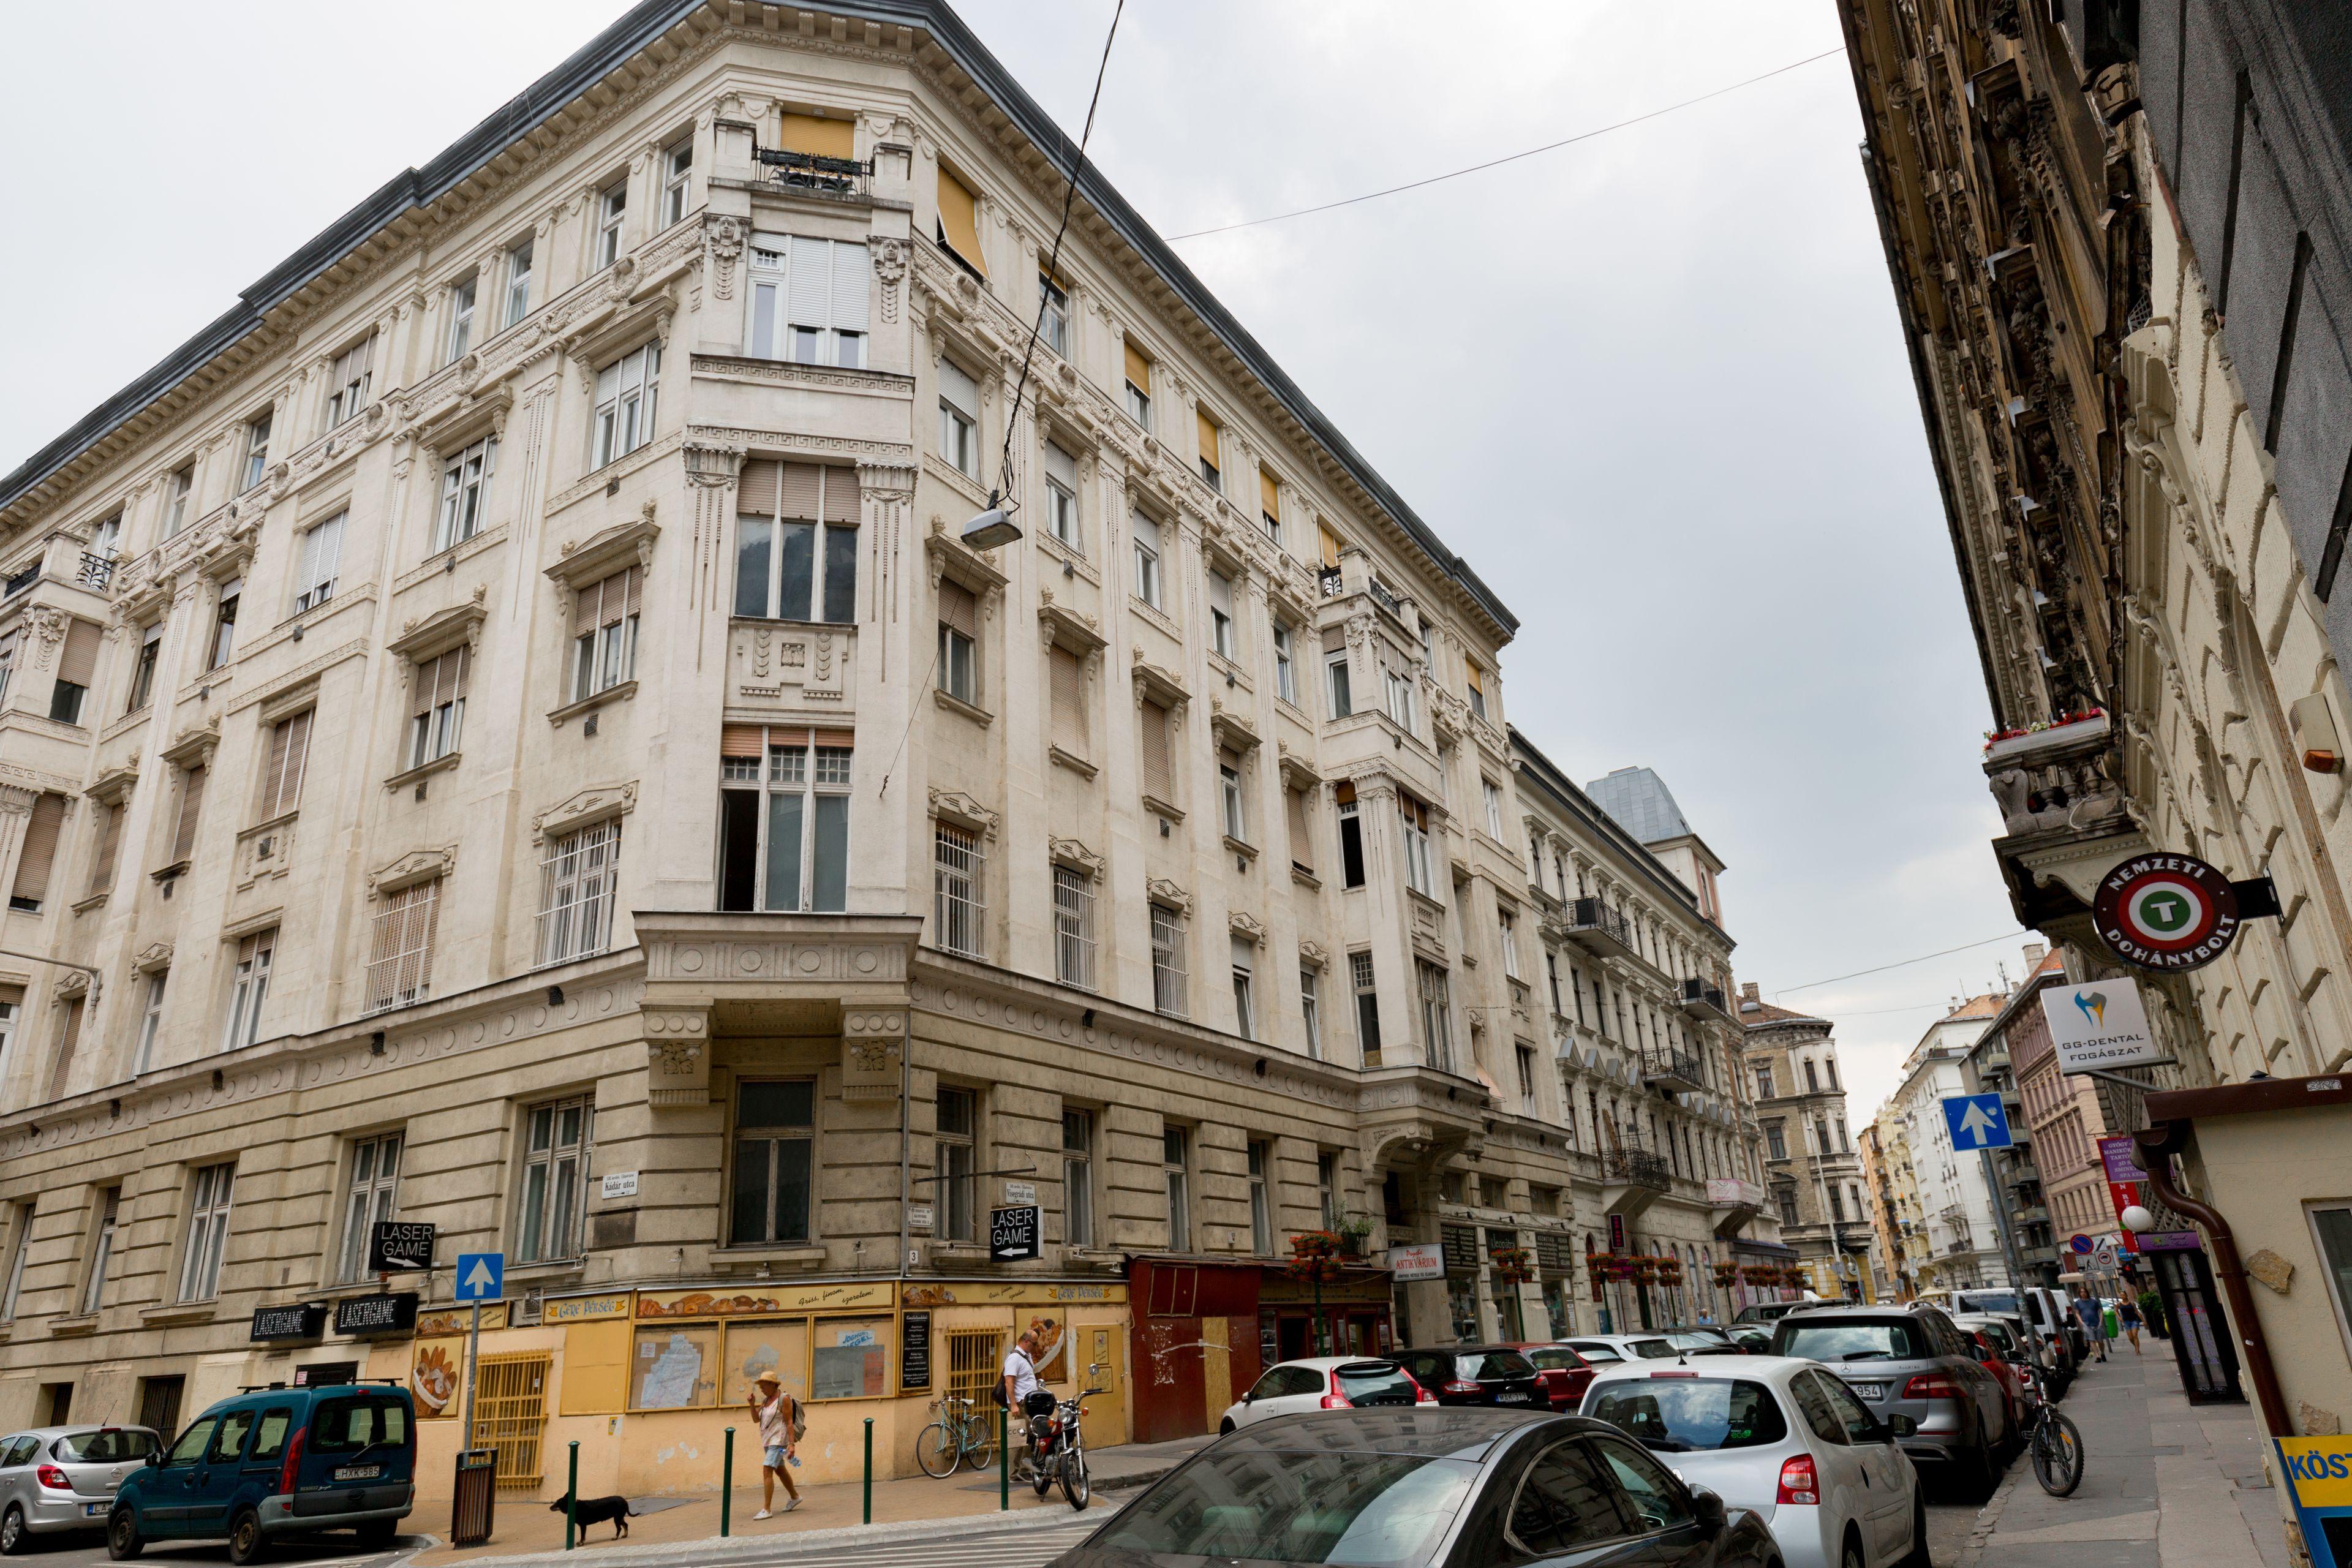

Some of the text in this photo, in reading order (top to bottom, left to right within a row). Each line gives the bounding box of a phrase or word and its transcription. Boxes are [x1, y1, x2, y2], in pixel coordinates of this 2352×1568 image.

[2108, 858, 2205, 890] NEMZETI
[2150, 901, 2177, 922] T
[2106, 914, 2235, 965] DOHÁNYBOLT
[2062, 1034, 2144, 1049] GG-DENTAL
[2070, 1047, 2143, 1061] FOGÁSZAT
[605, 1181, 621, 1191] Kádár
[1007, 1189, 1025, 1199] Visegrádi
[991, 1209, 1033, 1229] LASER
[381, 1225, 432, 1240] LASER
[993, 1227, 1031, 1245] GAME
[382, 1241, 429, 1256] GAME
[911, 1252, 916, 1261] 3
[842, 1288, 874, 1305] szeretem!
[341, 1467, 379, 1478] HXK-585
